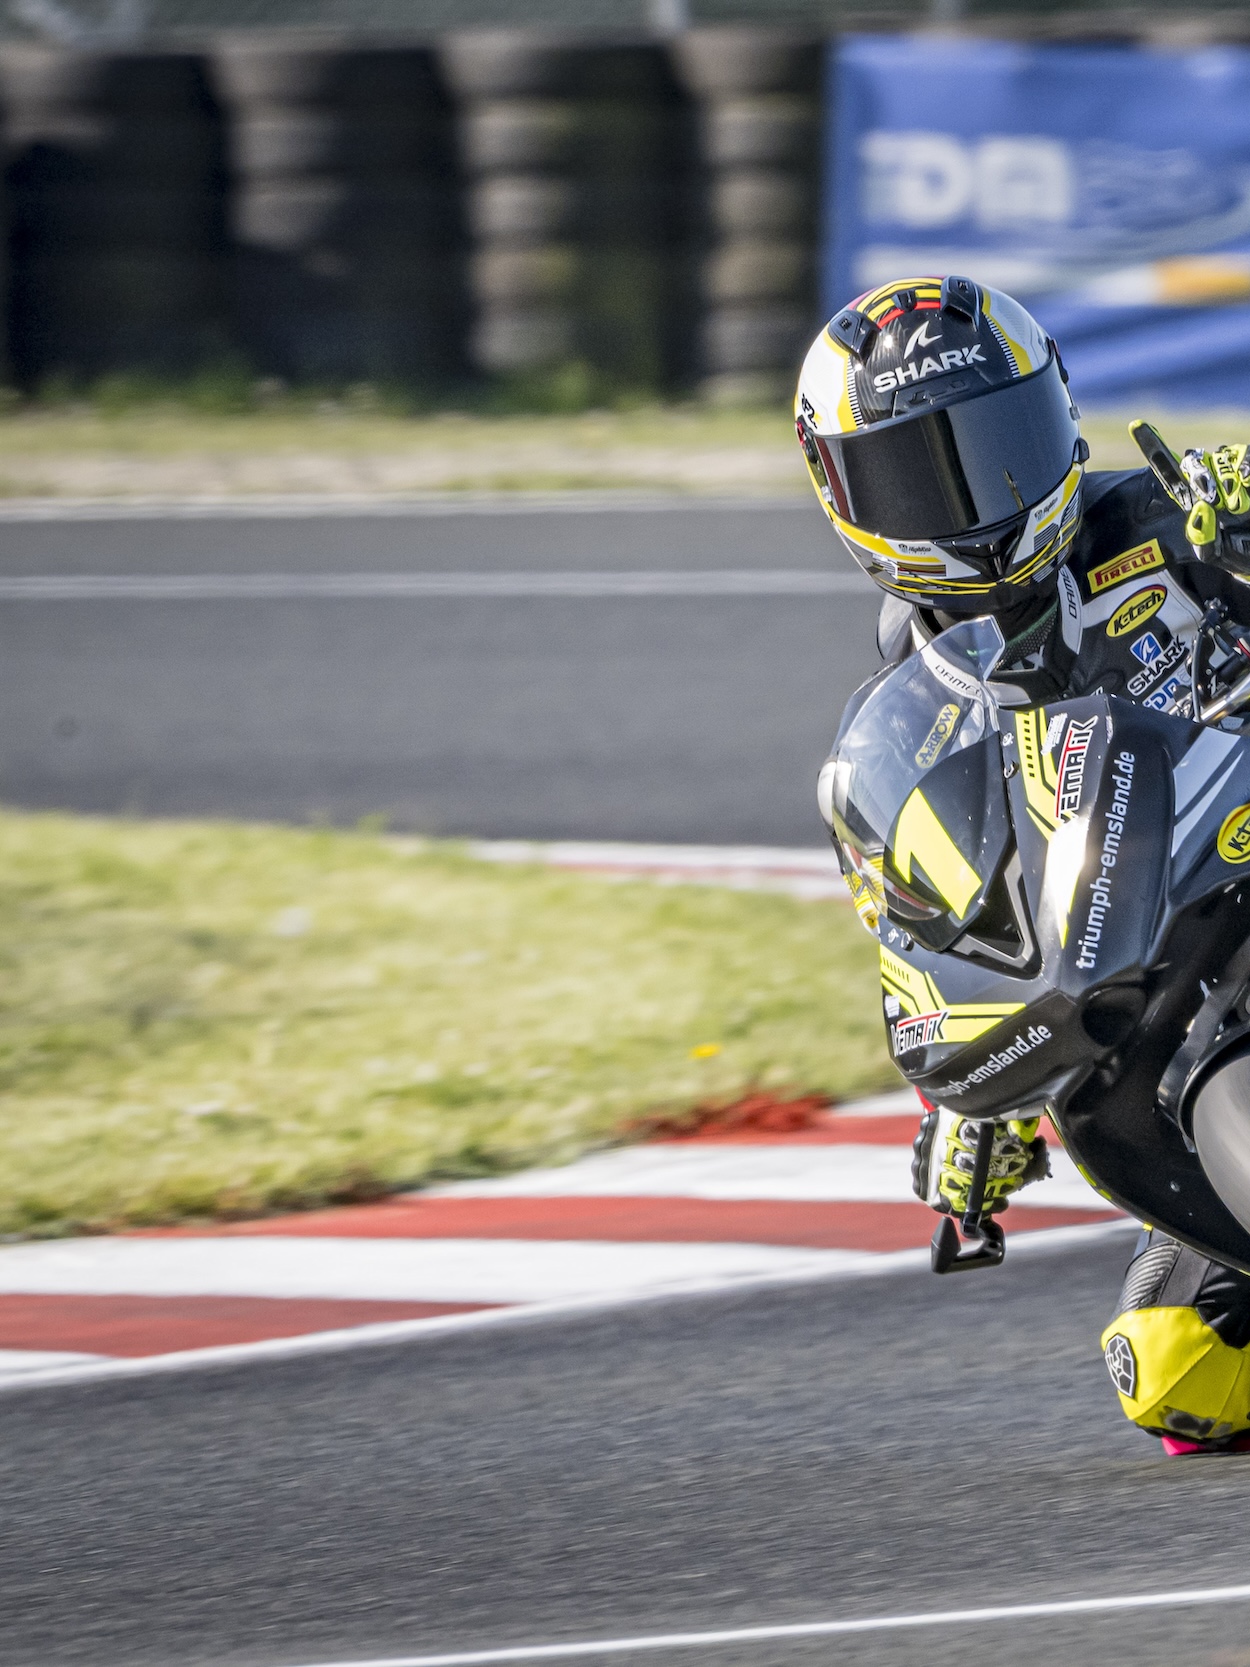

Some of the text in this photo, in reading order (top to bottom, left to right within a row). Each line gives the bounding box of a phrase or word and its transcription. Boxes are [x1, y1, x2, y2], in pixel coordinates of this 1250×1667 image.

[873, 343, 987, 393] SHARK
[1060, 567, 1078, 620] DAME
[1094, 546, 1156, 588] PIRELLI
[1129, 635, 1187, 694] SHARK
[918, 706, 954, 765] ARROW
[894, 787, 982, 920] 1
[1076, 751, 1136, 970] triumph-emsland.de
[938, 1024, 1052, 1096] ph-emsland.de
